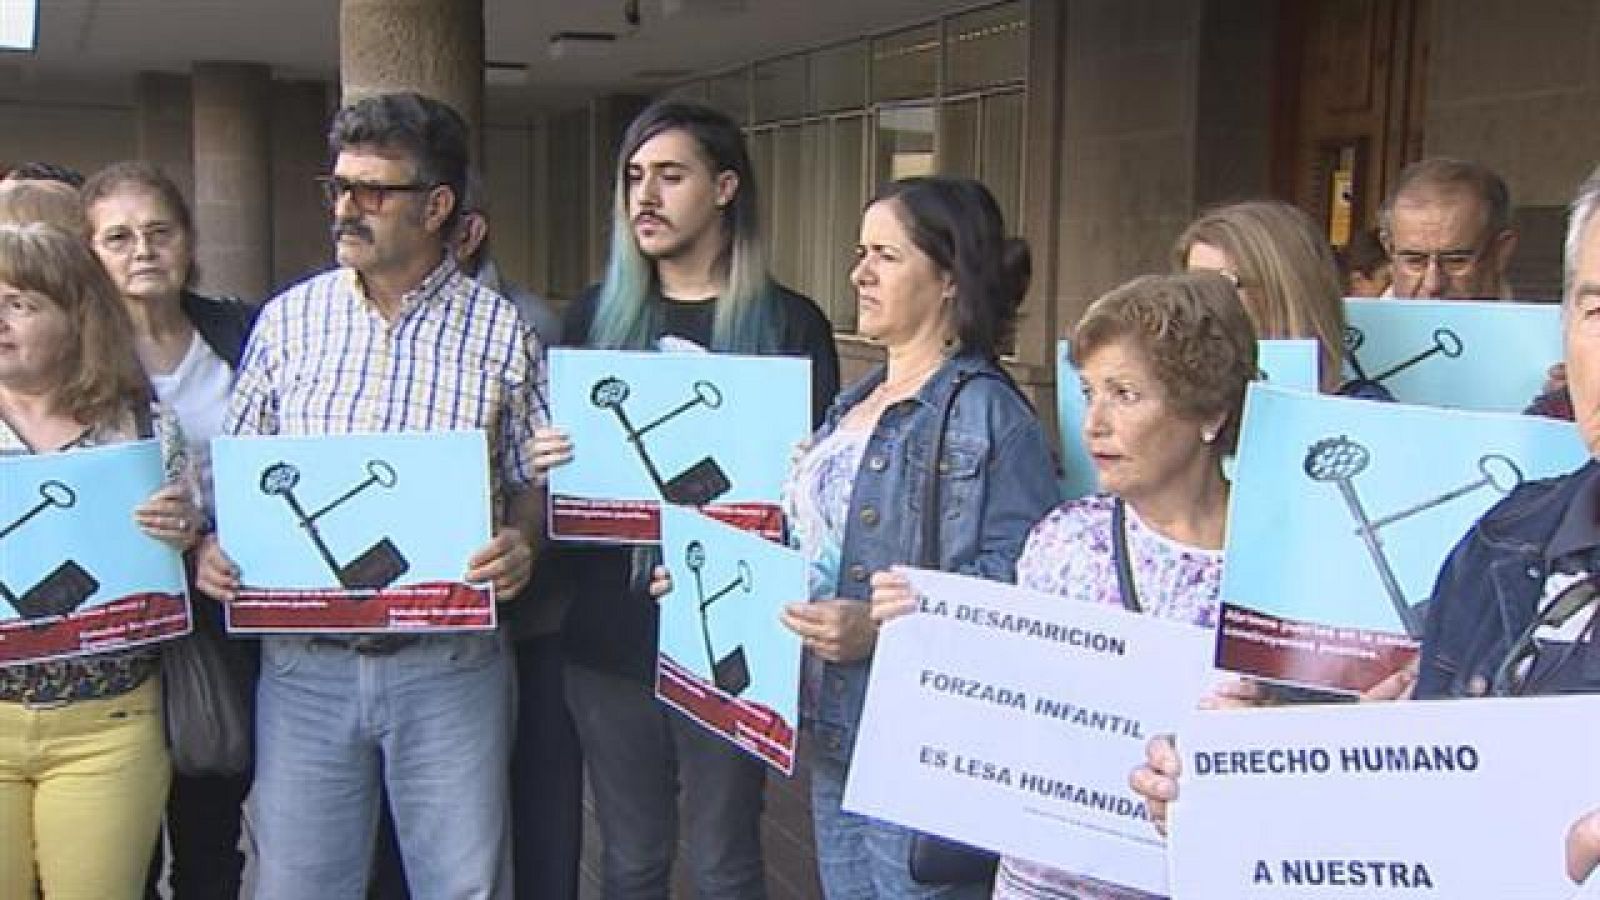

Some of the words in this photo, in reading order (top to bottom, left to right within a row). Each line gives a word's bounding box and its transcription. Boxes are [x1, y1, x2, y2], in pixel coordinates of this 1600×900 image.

[955, 604, 1126, 655] DESAPARICION
[919, 668, 1027, 711] FORZADA
[1034, 697, 1144, 740] INFANTIL
[919, 744, 948, 768] ES
[954, 753, 1012, 786] LESA
[1019, 771, 1154, 822] HUMANIDA
[1195, 746, 1331, 777] DERECHO
[1339, 744, 1480, 773] HUMANO
[1253, 859, 1273, 884] A
[1281, 859, 1434, 889] NUESTRA
